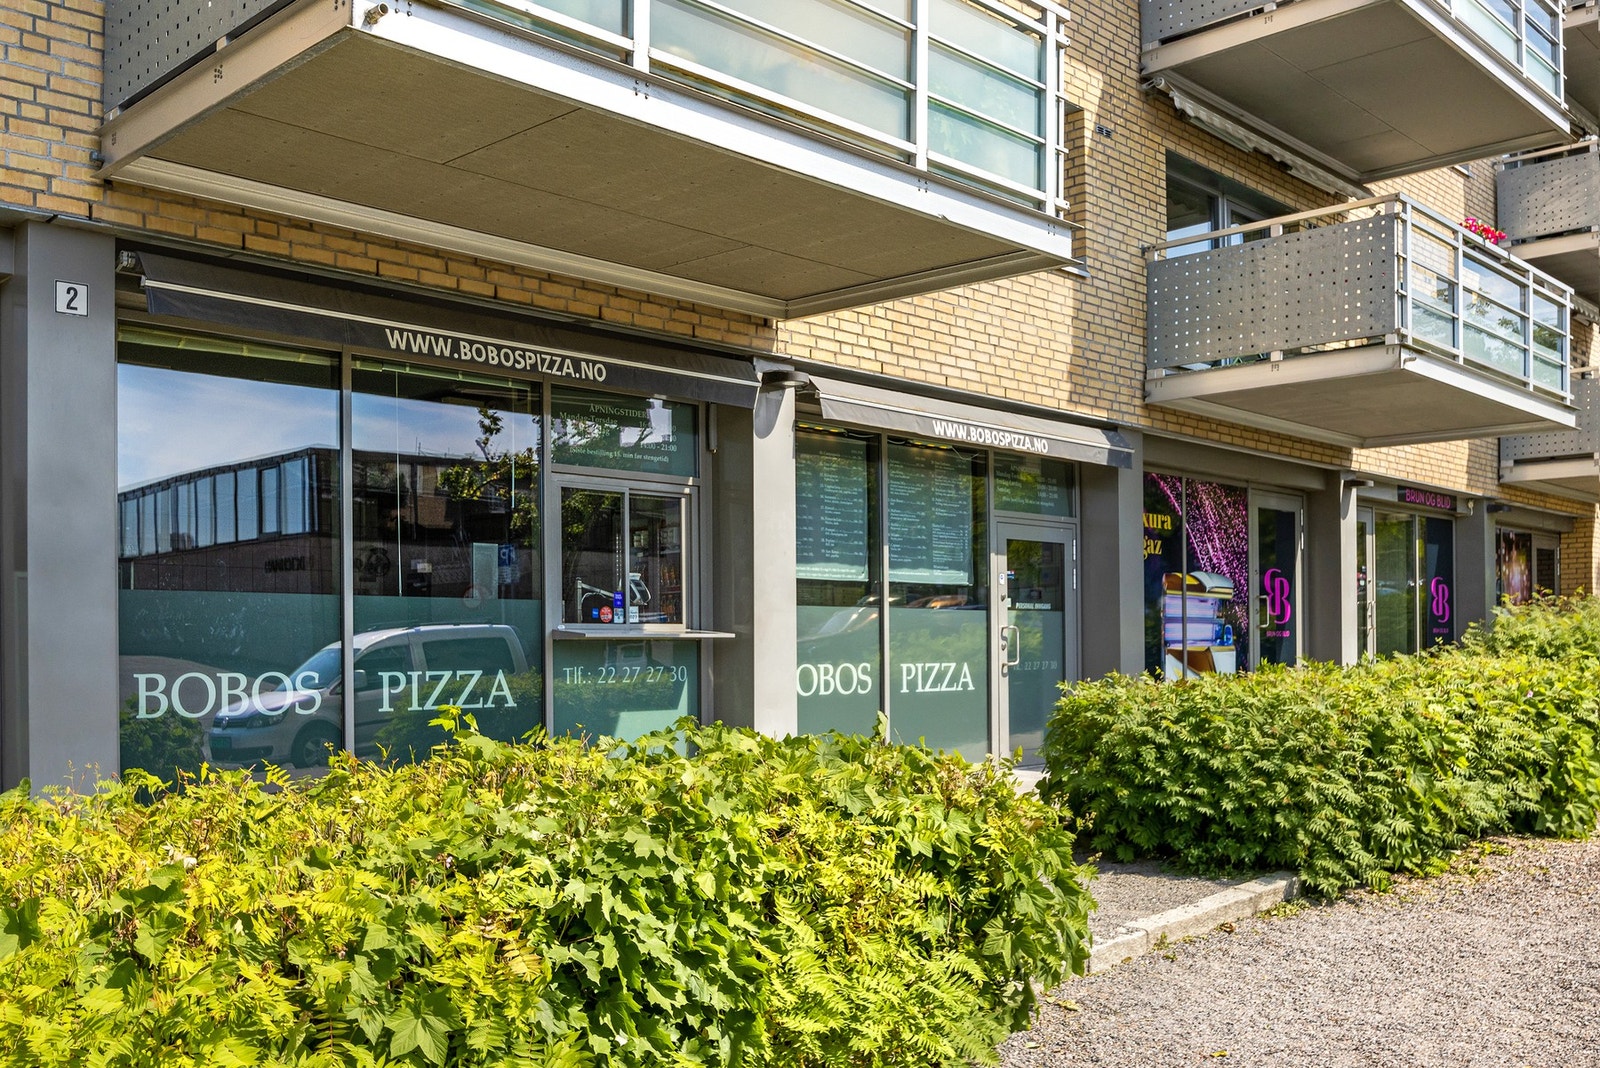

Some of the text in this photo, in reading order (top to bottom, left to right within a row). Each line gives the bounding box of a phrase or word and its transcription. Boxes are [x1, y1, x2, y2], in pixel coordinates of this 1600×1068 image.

[66, 286, 79, 311] 2
[385, 328, 607, 382] WWW.BOBOSPIZZA.NO
[932, 420, 1048, 453] WWW.BOBOSPIZZA.NO
[1405, 488, 1425, 504] BRUN
[1425, 492, 1436, 506] OG
[598, 667, 616, 684] 22
[622, 667, 641, 683] 27
[646, 666, 664, 683] 27
[670, 665, 688, 682] 30
[797, 662, 975, 696] OBOS PIZZA
[133, 669, 517, 719] BOBOS PIZZA
